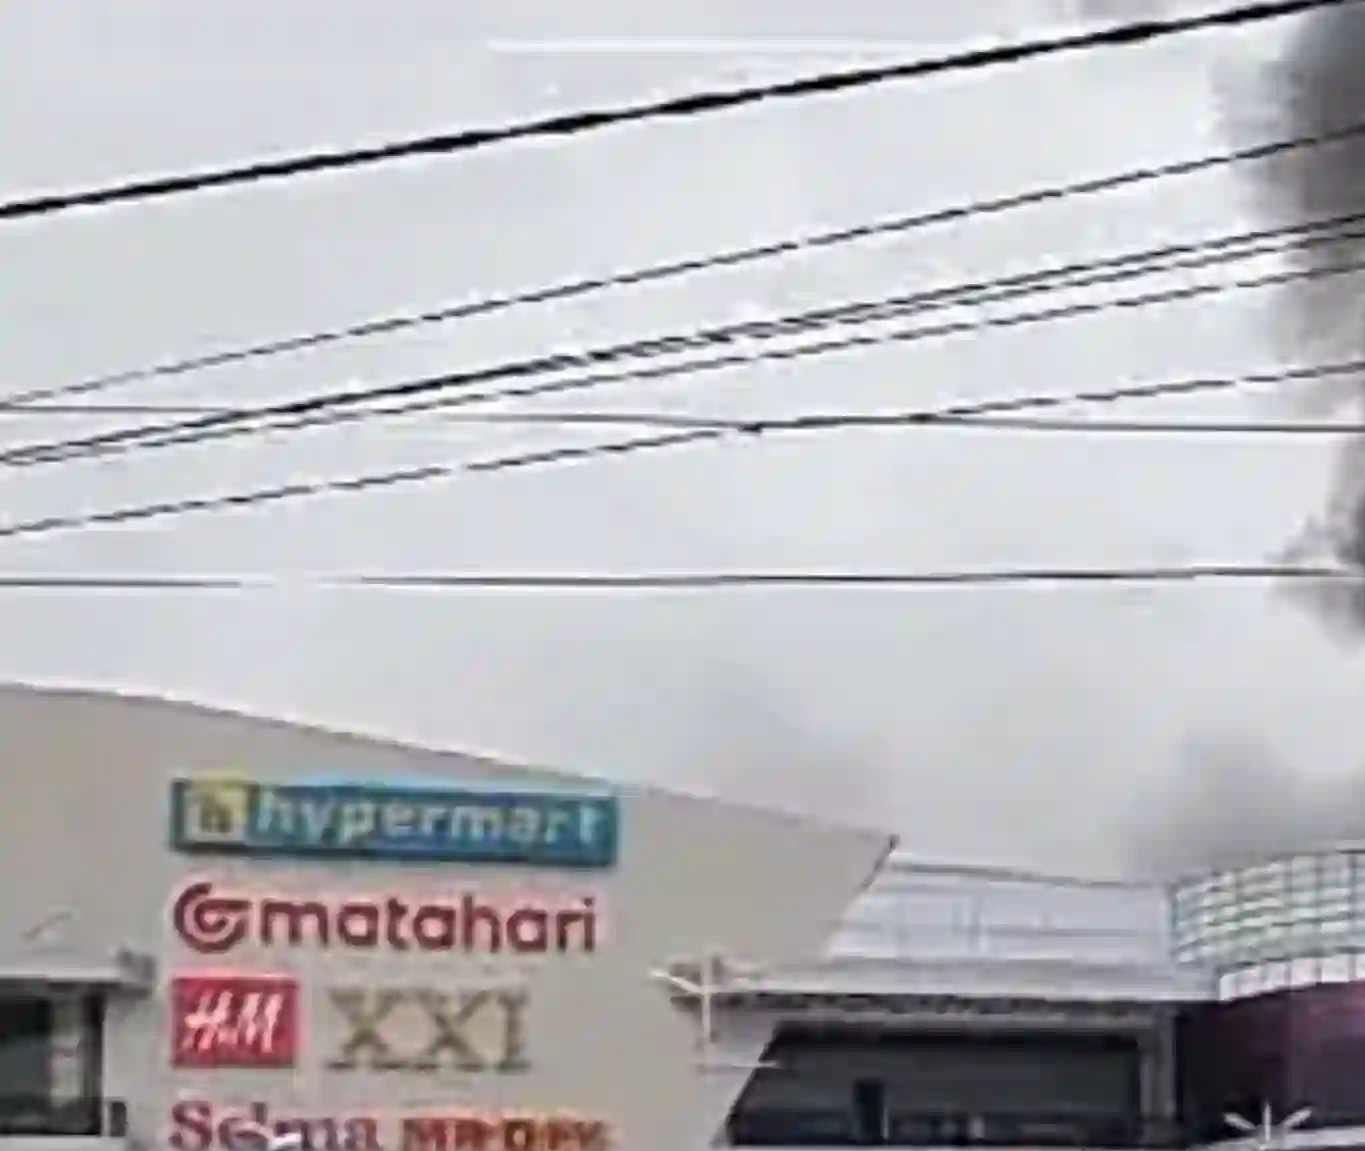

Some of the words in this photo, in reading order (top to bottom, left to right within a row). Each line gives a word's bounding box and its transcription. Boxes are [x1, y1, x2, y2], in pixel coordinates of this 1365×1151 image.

[255, 791, 606, 846] hypermart
[260, 892, 597, 954] matahari
[325, 986, 531, 1073] XXI
